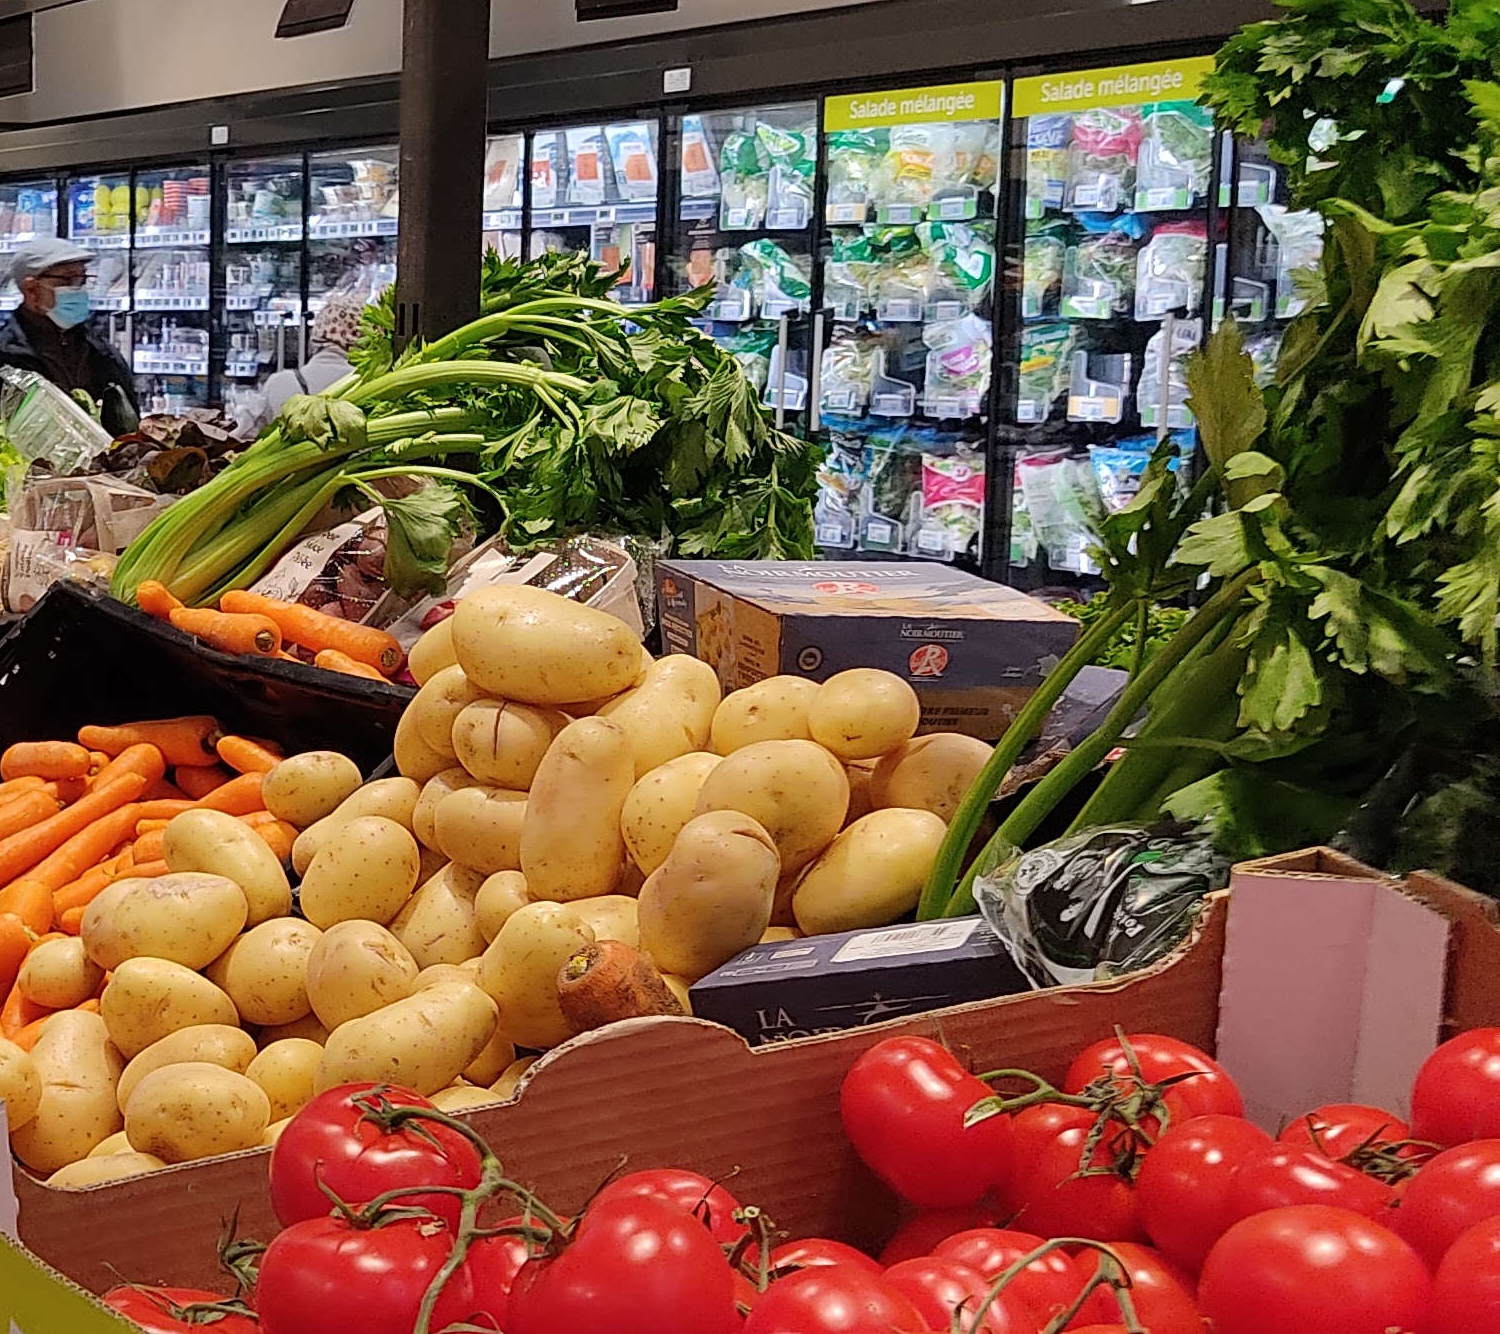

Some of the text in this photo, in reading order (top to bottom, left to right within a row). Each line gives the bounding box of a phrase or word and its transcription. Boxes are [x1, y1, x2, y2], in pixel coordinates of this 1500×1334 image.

[1040, 68, 1184, 103] Salade mélangée
[848, 91, 975, 120] Salade mélangée
[724, 569, 920, 578] NOIRMOUTIER
[755, 1007, 797, 1030] LA
